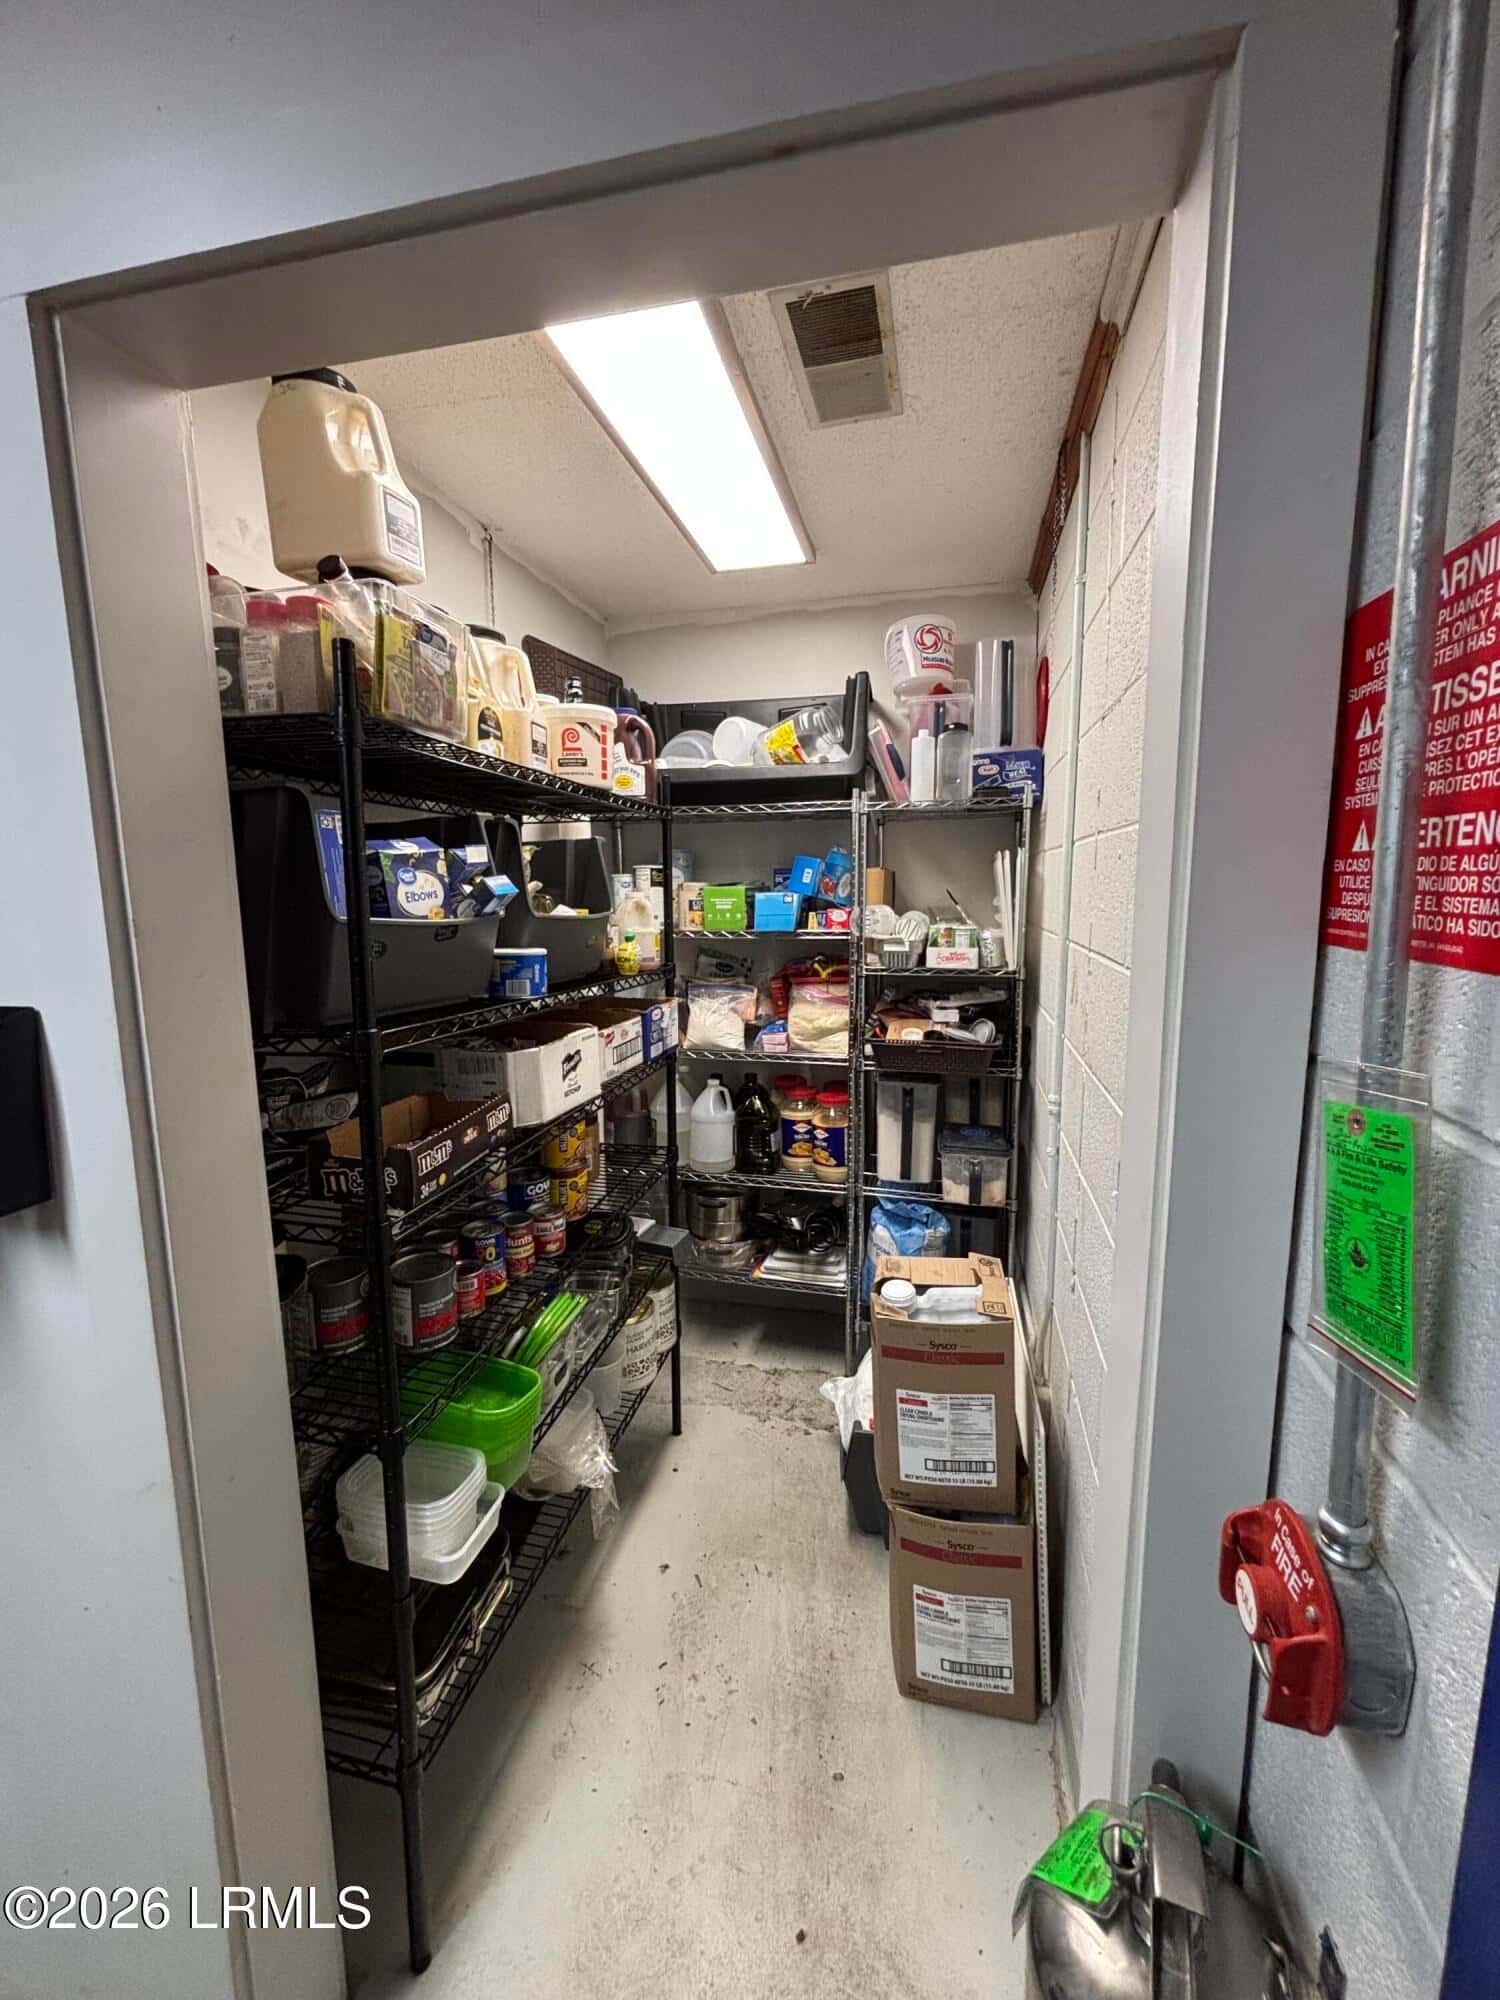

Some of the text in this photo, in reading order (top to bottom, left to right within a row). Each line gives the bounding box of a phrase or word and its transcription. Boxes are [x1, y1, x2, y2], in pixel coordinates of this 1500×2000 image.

[1452, 608, 1490, 639] ONLY
[1467, 626, 1497, 654] HAS
[1434, 715, 1460, 737] SUR
[1464, 707, 1484, 728] UN
[1455, 728, 1484, 751] CET
[1456, 742, 1500, 771] L'OPÉ
[1345, 859, 1371, 873] CASO
[1440, 856, 1458, 872] DE
[1339, 875, 1371, 890] UTILICE
[405, 889, 439, 904] Elbows
[1424, 896, 1439, 912] EL
[1446, 917, 1465, 936] HA
[929, 1340, 959, 1352] Sysco
[947, 1539, 976, 1552] Sysco
[1281, 1524, 1301, 1568] Case
[1271, 1533, 1303, 1603] FIRE
